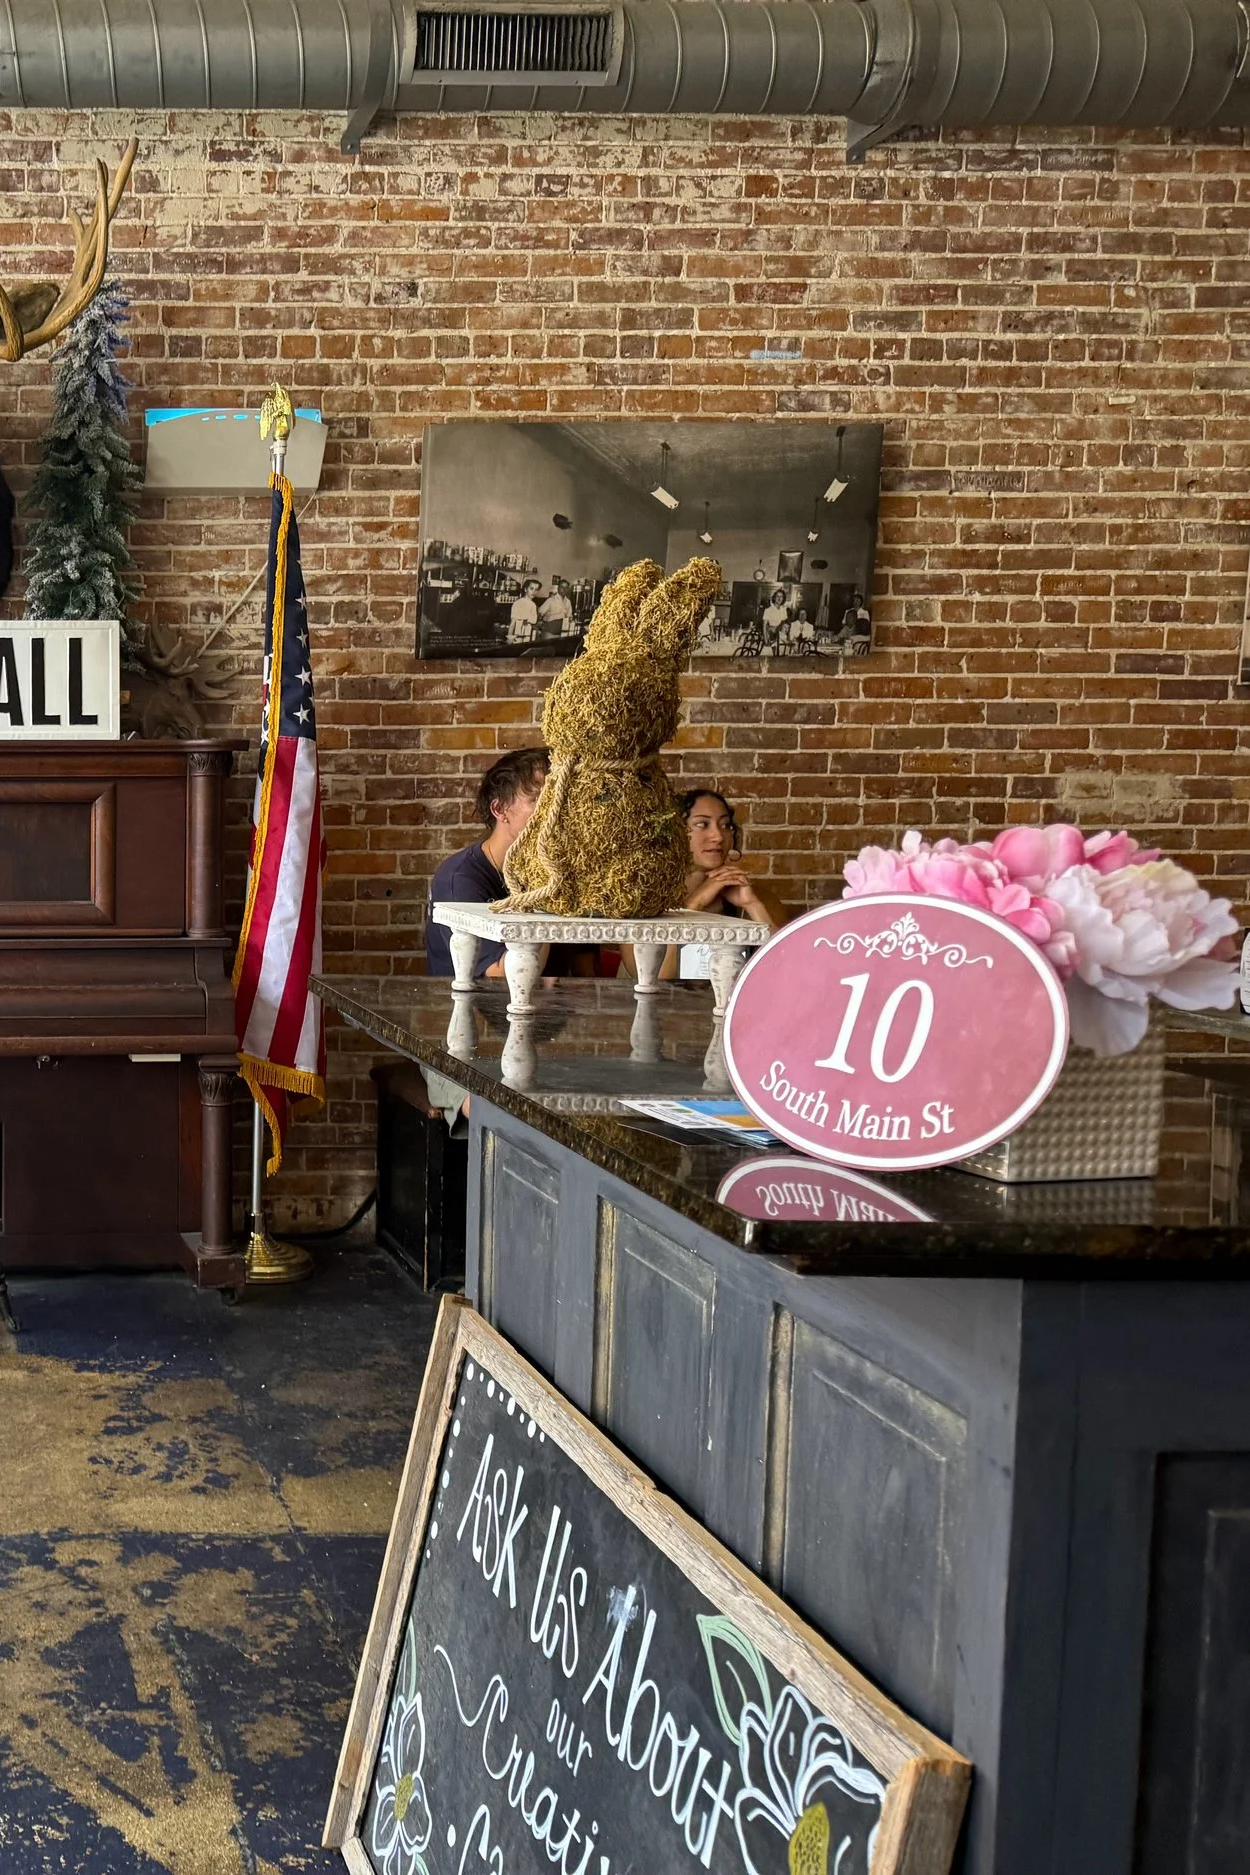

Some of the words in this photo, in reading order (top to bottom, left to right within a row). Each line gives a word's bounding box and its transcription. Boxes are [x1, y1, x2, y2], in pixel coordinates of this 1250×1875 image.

[815, 972, 935, 1083] 10
[759, 1060, 830, 1128] South
[833, 1100, 911, 1141] Main
[921, 1102, 955, 1139] St
[457, 1433, 529, 1609] Ask
[530, 1505, 587, 1679] Us
[582, 1584, 734, 1870] About
[546, 1698, 593, 1777] our
